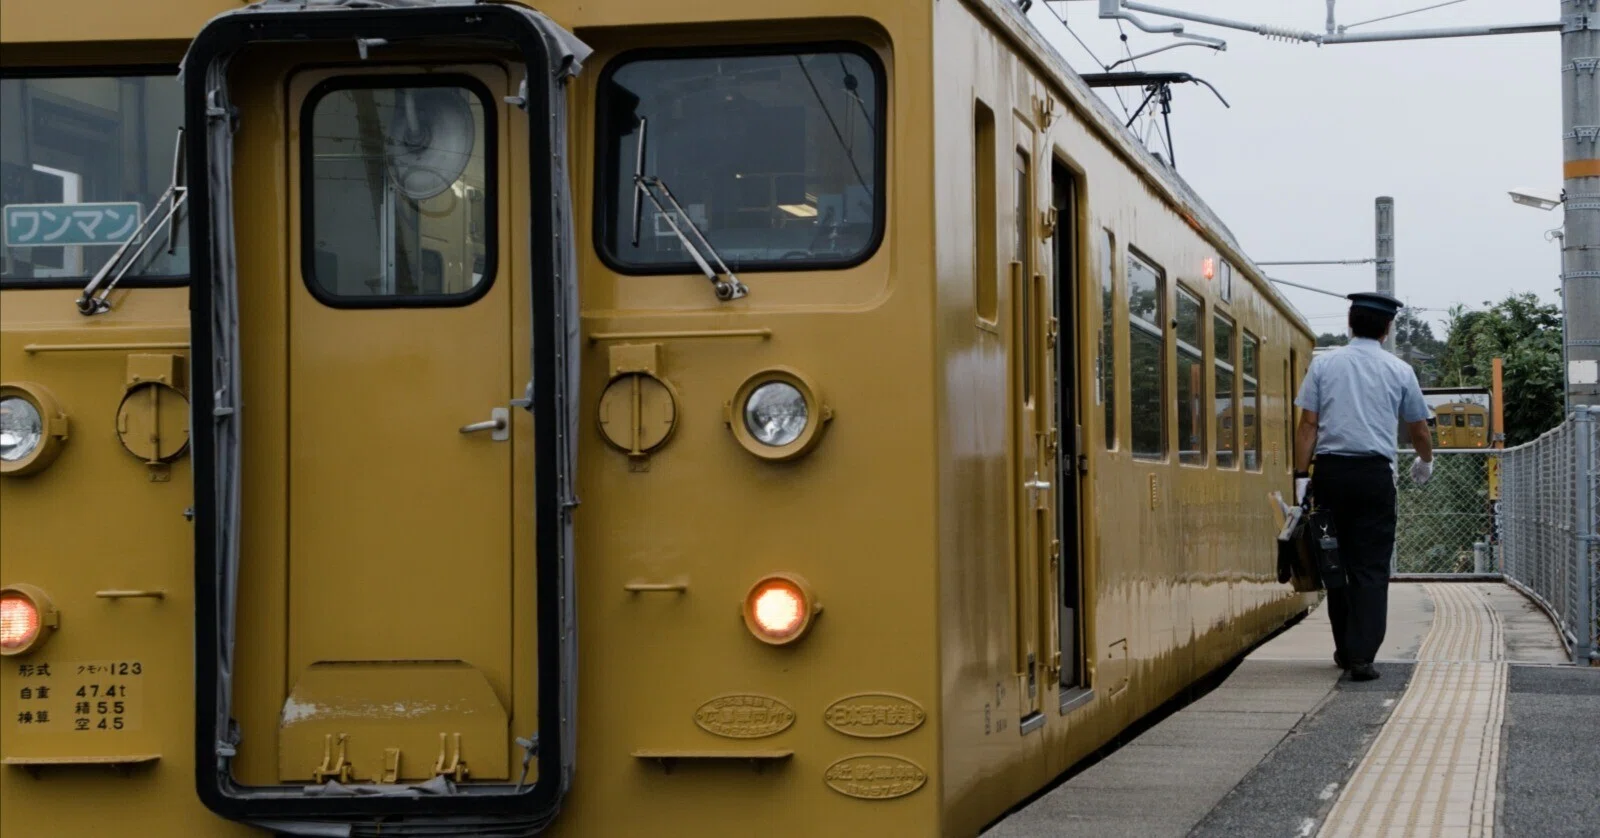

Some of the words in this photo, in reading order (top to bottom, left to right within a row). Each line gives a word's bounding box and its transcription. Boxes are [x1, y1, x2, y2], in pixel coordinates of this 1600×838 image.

[11, 208, 135, 241] ワンマン
[18, 662, 51, 677] 形式
[77, 662, 142, 675] クモハ123
[20, 685, 51, 699] 自重
[75, 684, 126, 698] 47.4t
[17, 710, 51, 724] 換算
[74, 717, 91, 731] 空
